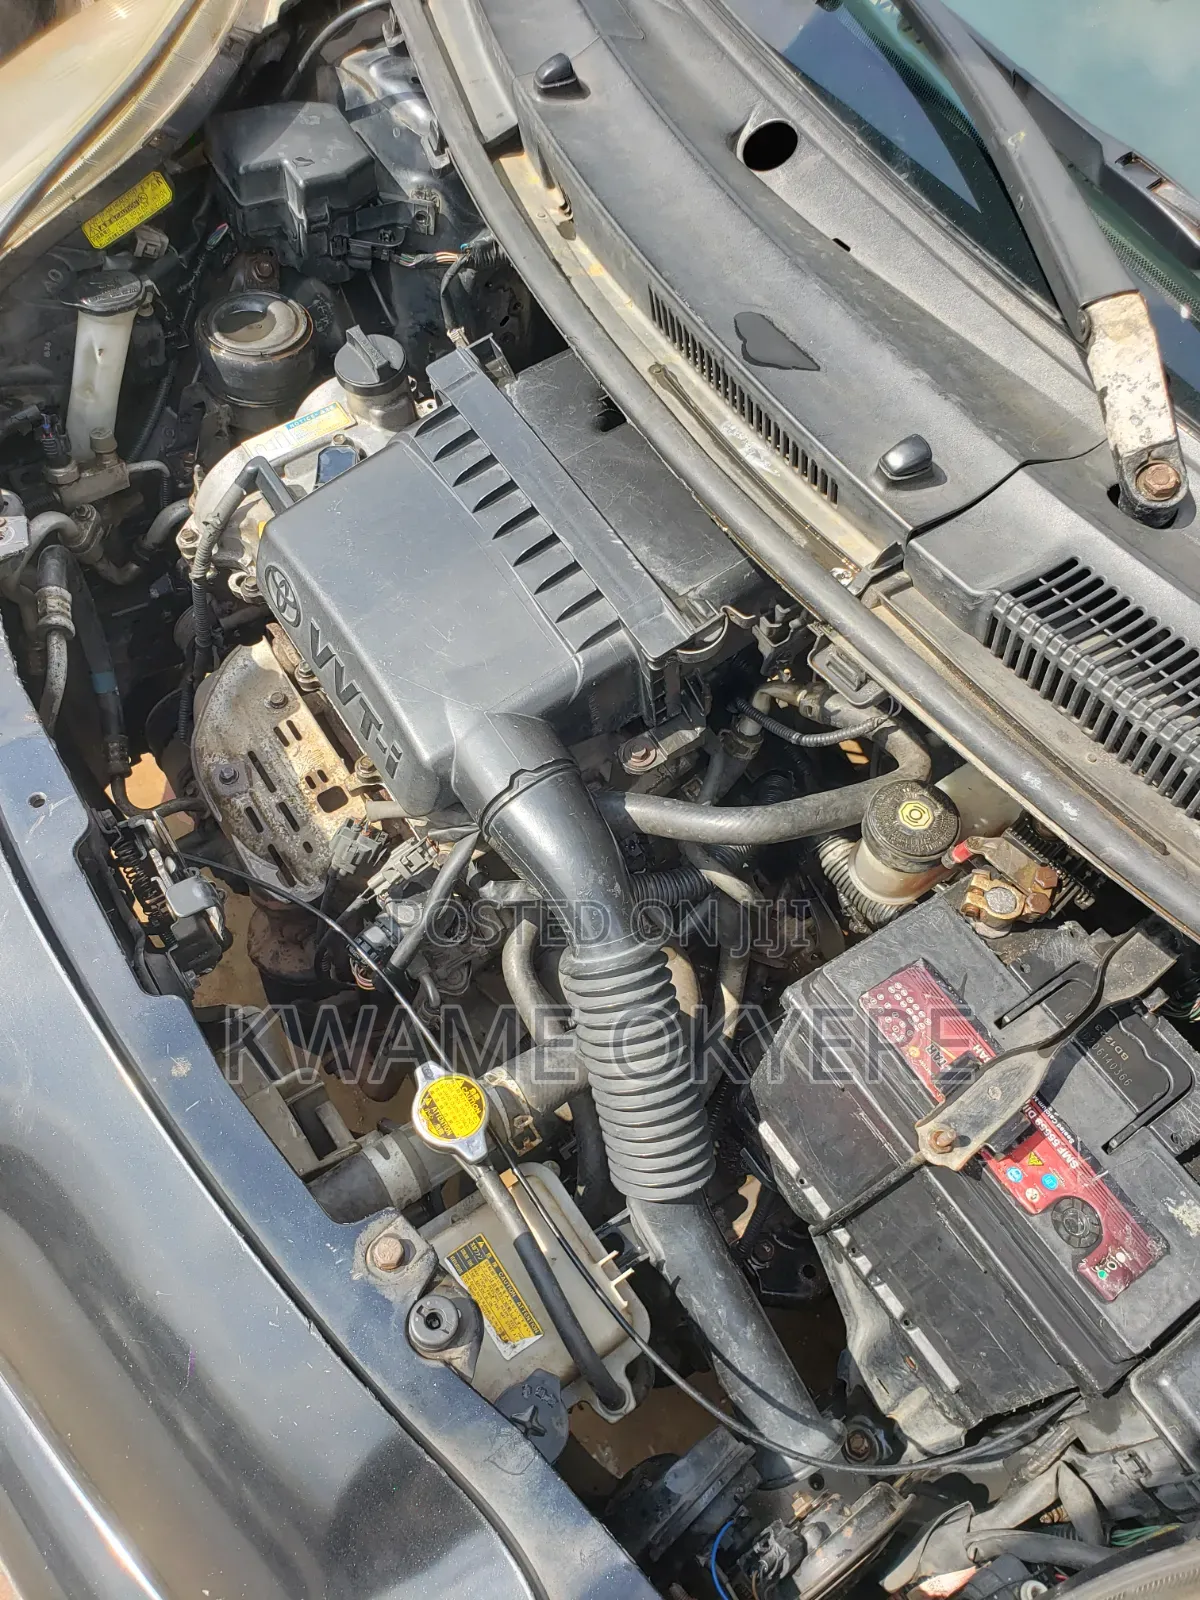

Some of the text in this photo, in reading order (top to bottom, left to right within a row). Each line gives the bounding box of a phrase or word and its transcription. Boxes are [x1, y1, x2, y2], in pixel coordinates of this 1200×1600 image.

[309, 617, 404, 780] VVT-i
[460, 1085, 481, 1113] CAUTION
[430, 1105, 452, 1136] ATTENTION
[1033, 1116, 1061, 1147] 55559
[1055, 1123, 1075, 1144] Sealed
[1056, 1144, 1078, 1167] SMF
[497, 1271, 516, 1297] CAUTION
[515, 1300, 539, 1334] ATTENTION
